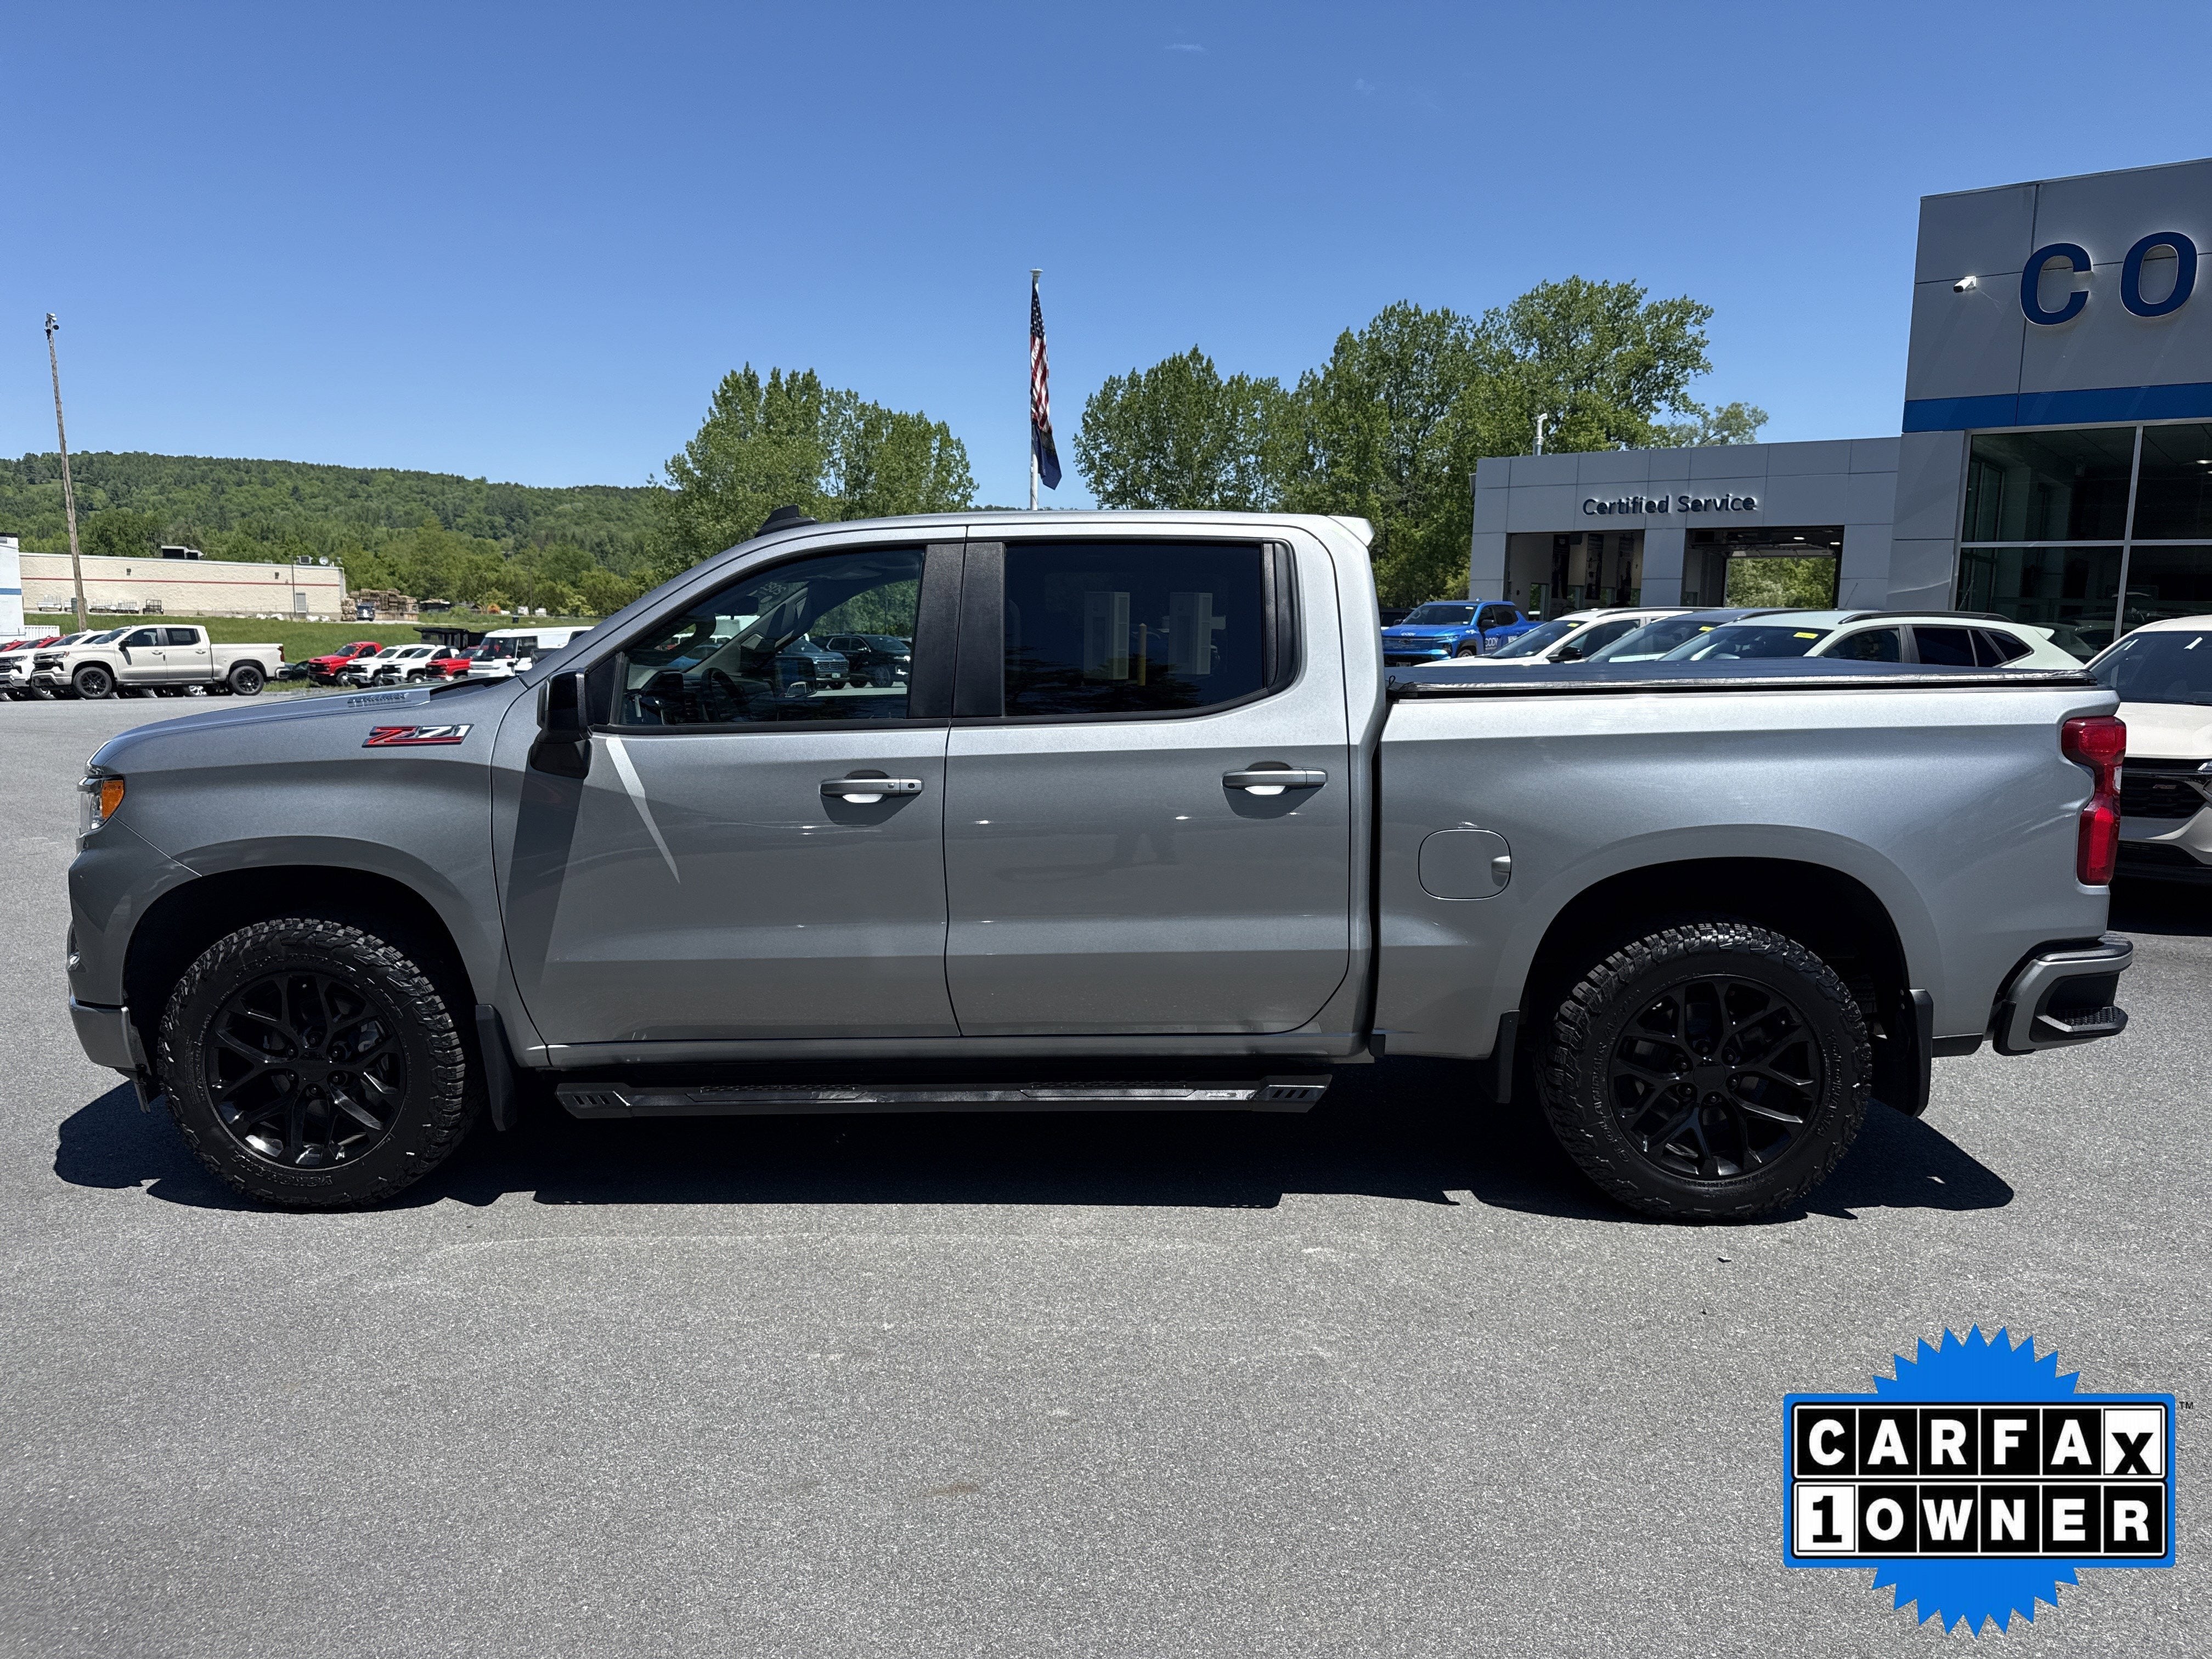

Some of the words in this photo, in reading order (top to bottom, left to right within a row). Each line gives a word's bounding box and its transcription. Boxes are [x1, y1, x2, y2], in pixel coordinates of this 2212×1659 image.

[2020, 231, 2198, 326] CO
[1583, 495, 1671, 516] Certified
[1677, 494, 1757, 512] Service
[362, 724, 474, 748] Z71
